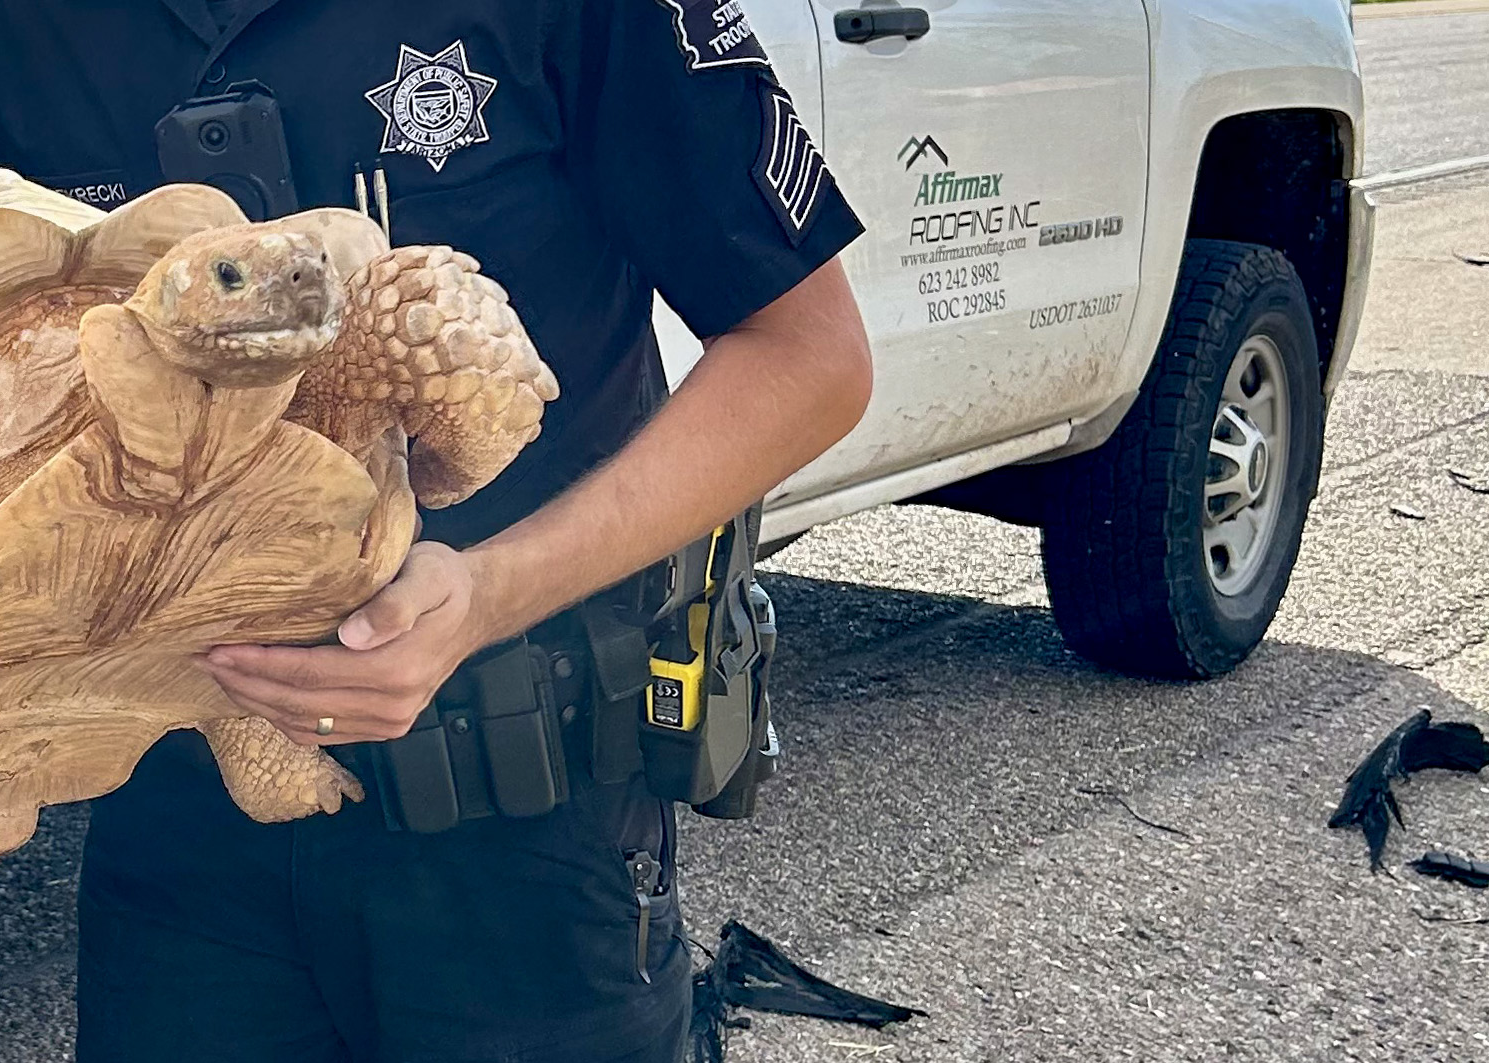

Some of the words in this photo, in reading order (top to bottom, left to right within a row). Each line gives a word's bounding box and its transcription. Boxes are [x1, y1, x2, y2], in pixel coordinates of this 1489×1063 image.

[55, 183, 127, 203] YRECKI
[914, 171, 1003, 207] Affirmax
[909, 206, 1004, 246] ROOFING
[1008, 201, 1040, 231] INC
[1039, 220, 1093, 247] 2500
[1095, 216, 1123, 238] HD
[900, 237, 1026, 267] www.affirmaxroofing.com
[919, 271, 942, 295] 623
[945, 267, 968, 290] 242
[971, 261, 1000, 287] 8982
[927, 297, 960, 323] ROC
[963, 289, 1006, 316] 292845
[1029, 301, 1077, 330] USDOT
[1077, 293, 1123, 319] 2631037
